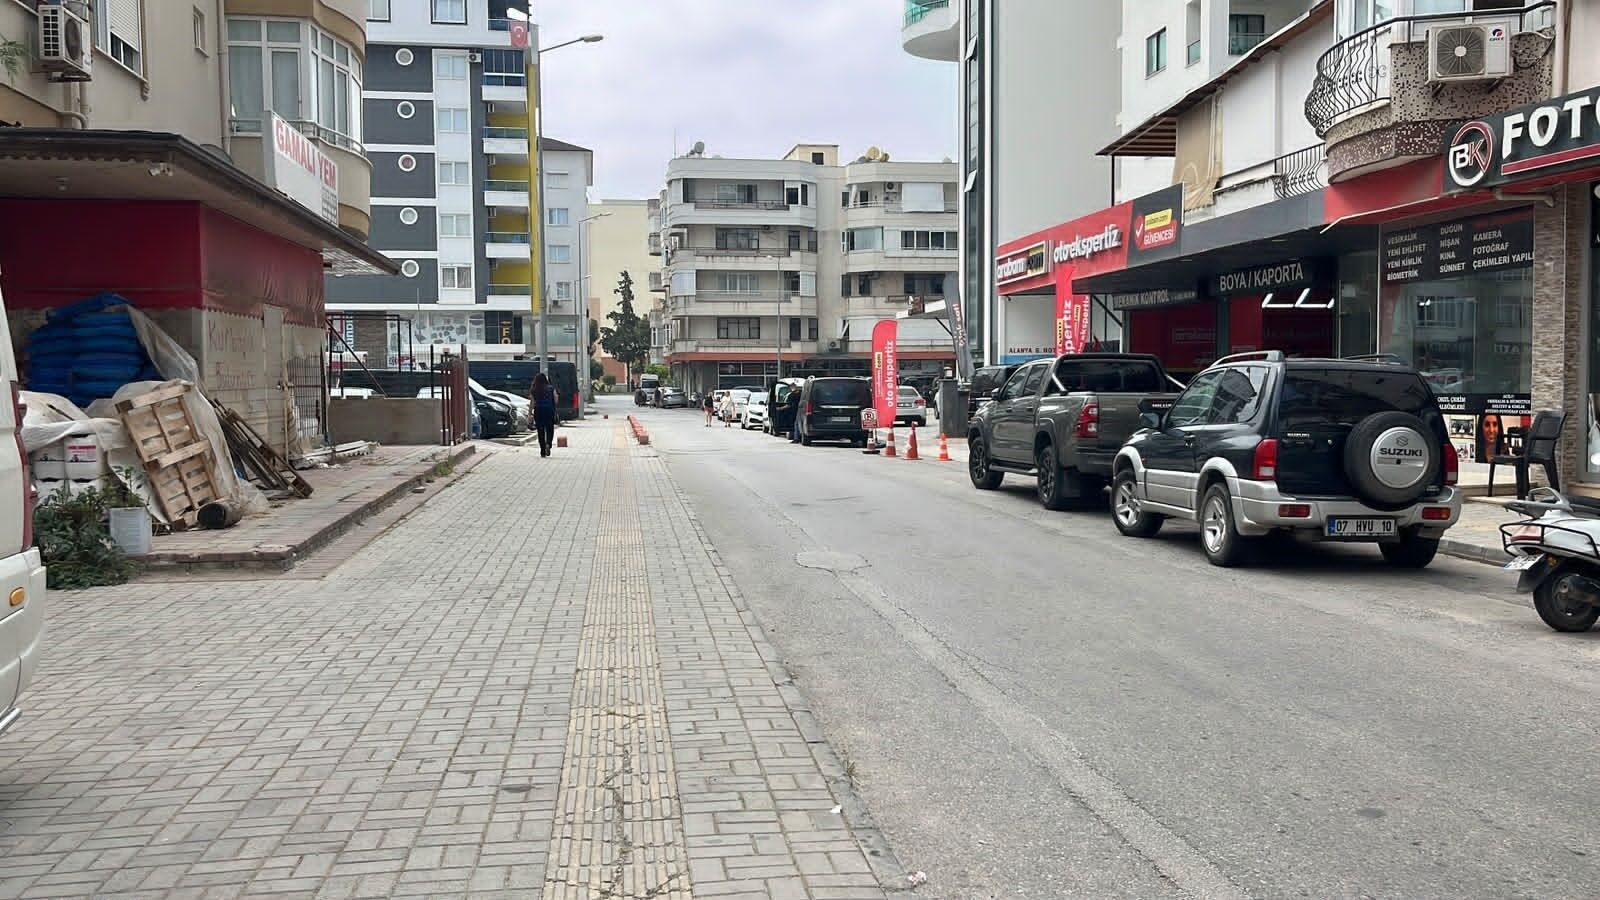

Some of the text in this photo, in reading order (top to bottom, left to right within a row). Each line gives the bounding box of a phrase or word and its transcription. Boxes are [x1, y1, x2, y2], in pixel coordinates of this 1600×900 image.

[1502, 96, 1600, 160] FOT
[276, 120, 337, 190] GAMALI YEM
[1069, 224, 1121, 258] ekspertiz
[1473, 229, 1502, 242] KAMERA
[1387, 243, 1426, 257] YENİ EHLİYET
[1440, 238, 1460, 249] NİŞAN
[1473, 242, 1510, 255] FOTOĞRAF
[1387, 255, 1423, 269] YENİ KİMLİK
[1440, 251, 1456, 261] KINA
[1473, 255, 1510, 270] ÇEKİMLERİ
[1440, 262, 1466, 274] SÜNNET
[1220, 271, 1247, 292] BOYA
[1254, 263, 1304, 287] KAPORTA
[1387, 269, 1419, 281] BİOMETRİK
[885, 341, 894, 407] oto ekspertiz
[1380, 447, 1422, 457] SUZUKI
[1336, 521, 1392, 532] 07 HVU 10
